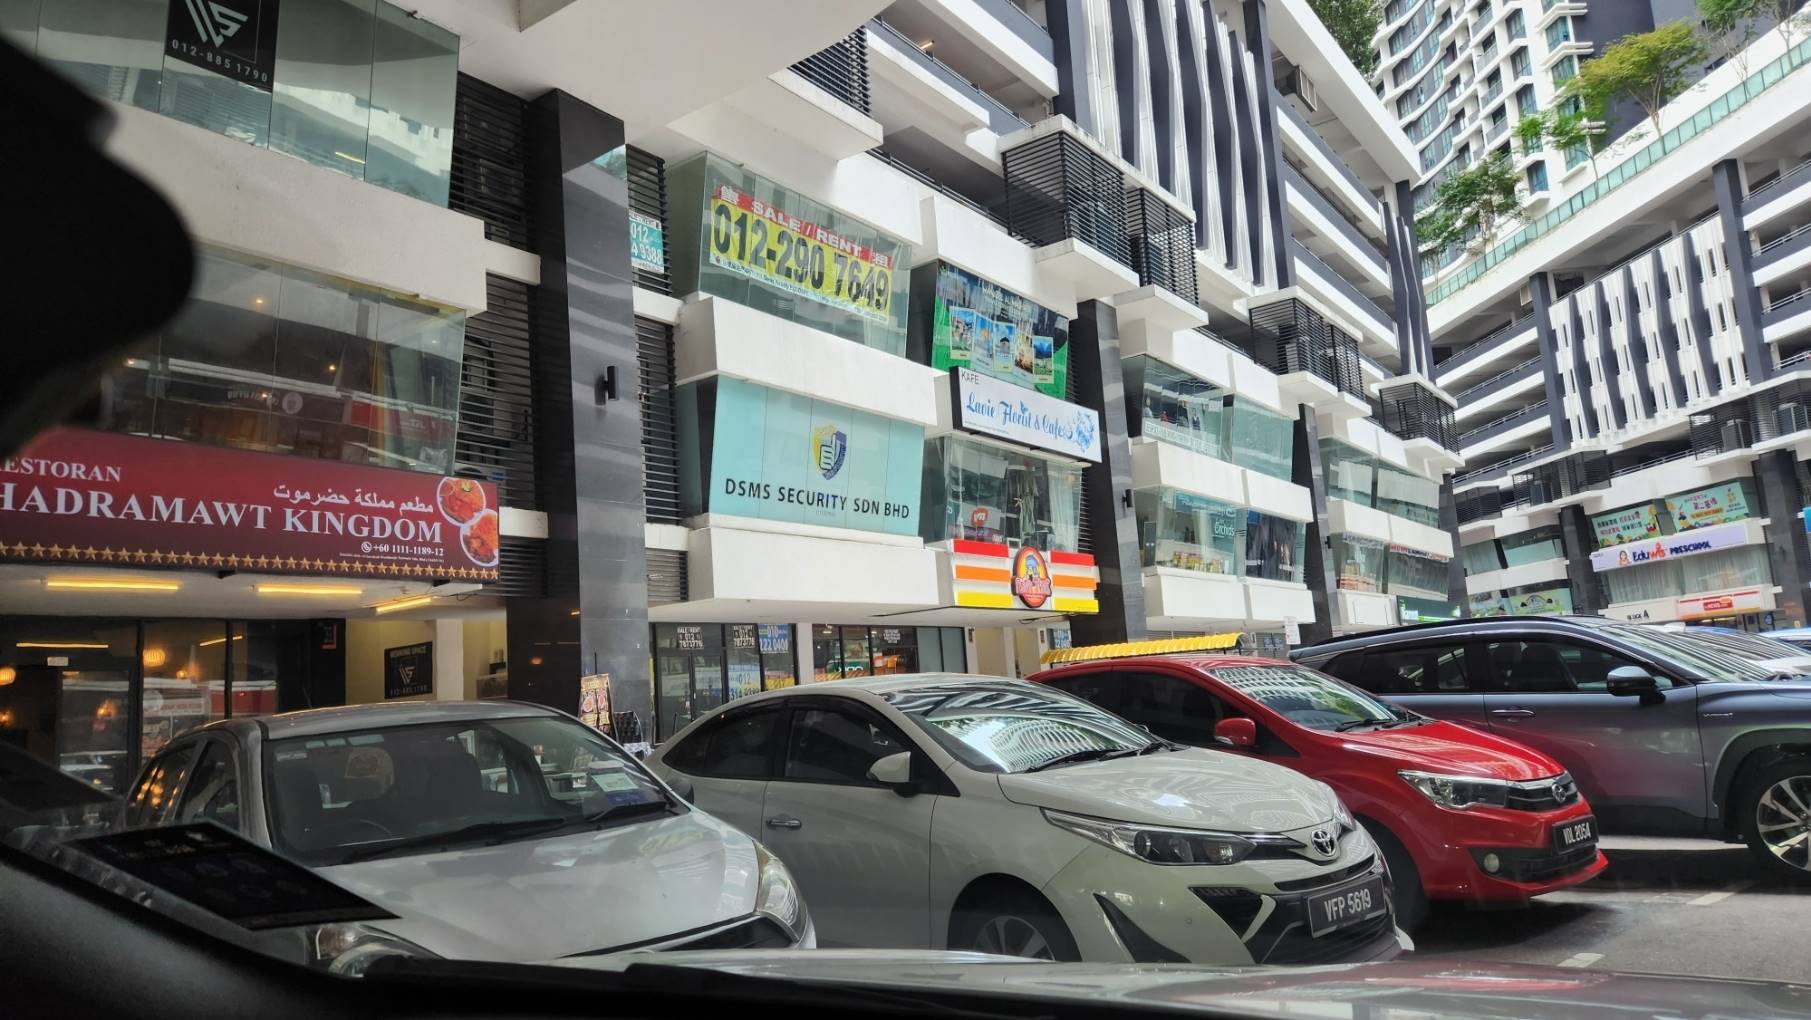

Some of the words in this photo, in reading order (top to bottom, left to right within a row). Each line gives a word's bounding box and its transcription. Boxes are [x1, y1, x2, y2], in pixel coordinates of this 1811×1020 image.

[751, 200, 801, 232] SALE
[815, 228, 862, 257] RENT
[713, 204, 825, 290] 012-290
[833, 252, 889, 311] 7649
[961, 370, 980, 385] KAFE
[354, 488, 396, 510] مملكة
[399, 496, 434, 516] مطعم
[725, 478, 771, 500] DSMS
[778, 486, 848, 511] SECURITY
[853, 497, 880, 516] SDN
[884, 502, 910, 519] BHD
[282, 508, 443, 544] KINGDOM
[373, 544, 390, 553] +60
[1669, 541, 1712, 556] PRESCHOOL
[1324, 899, 1346, 922] VFP
[1347, 888, 1372, 912] 5619
